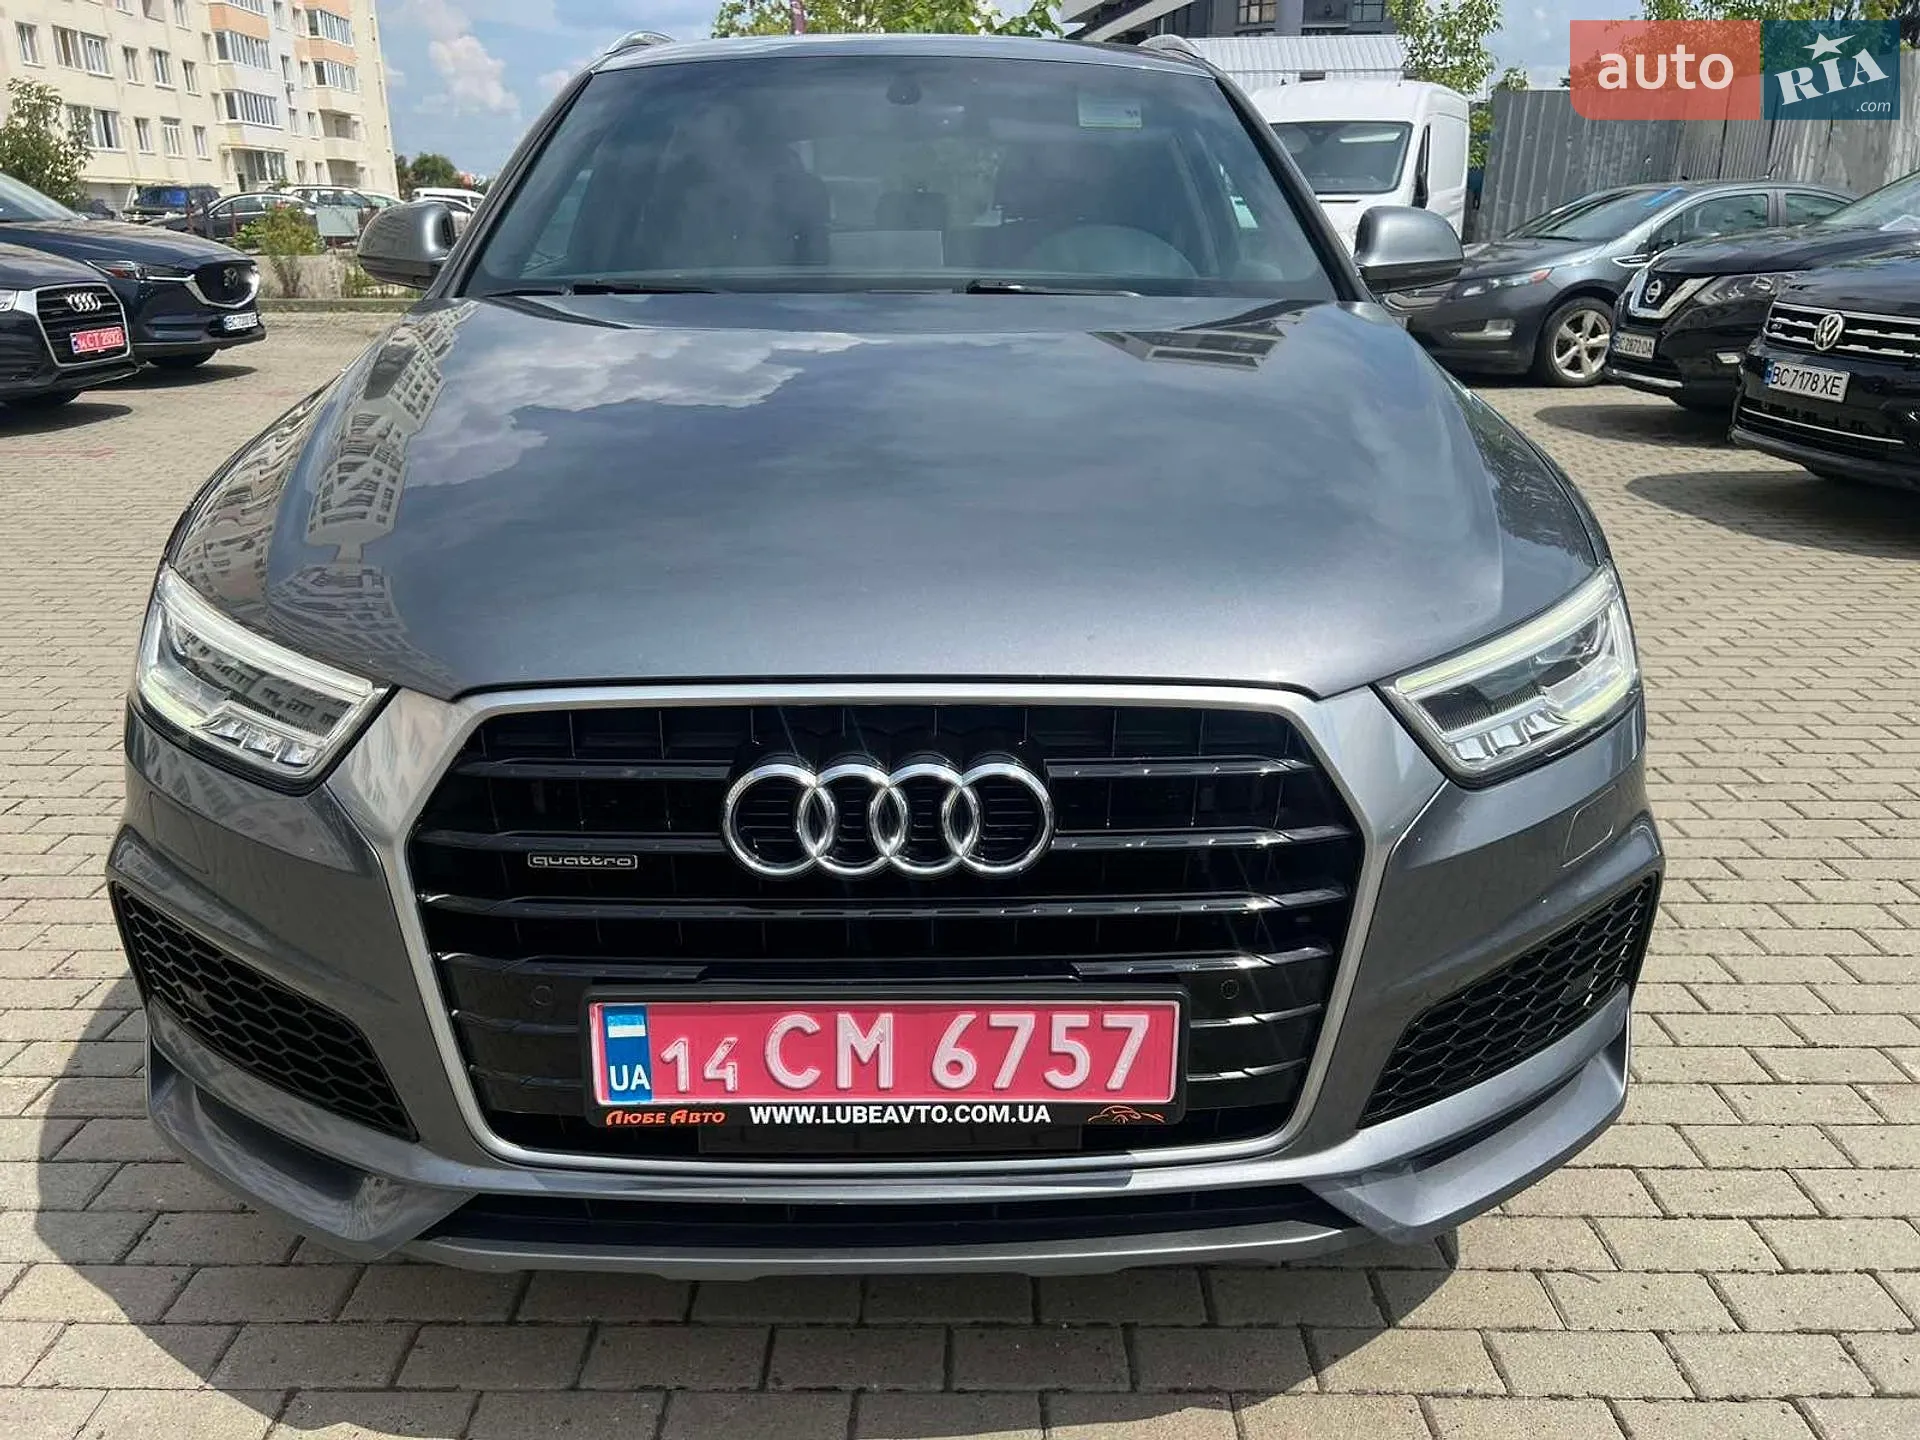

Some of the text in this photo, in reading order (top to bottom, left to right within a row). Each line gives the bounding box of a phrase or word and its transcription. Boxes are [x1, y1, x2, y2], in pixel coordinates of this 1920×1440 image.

[1771, 366, 1790, 386] BC
[1789, 369, 1820, 391] 7178
[1821, 375, 1842, 396] XE
[532, 856, 631, 867] quattro
[659, 1010, 1150, 1093] 14 CM 6757
[609, 1063, 651, 1092] UA
[749, 1104, 1051, 1125] WWW.LUBEAVTO.COM.UA
